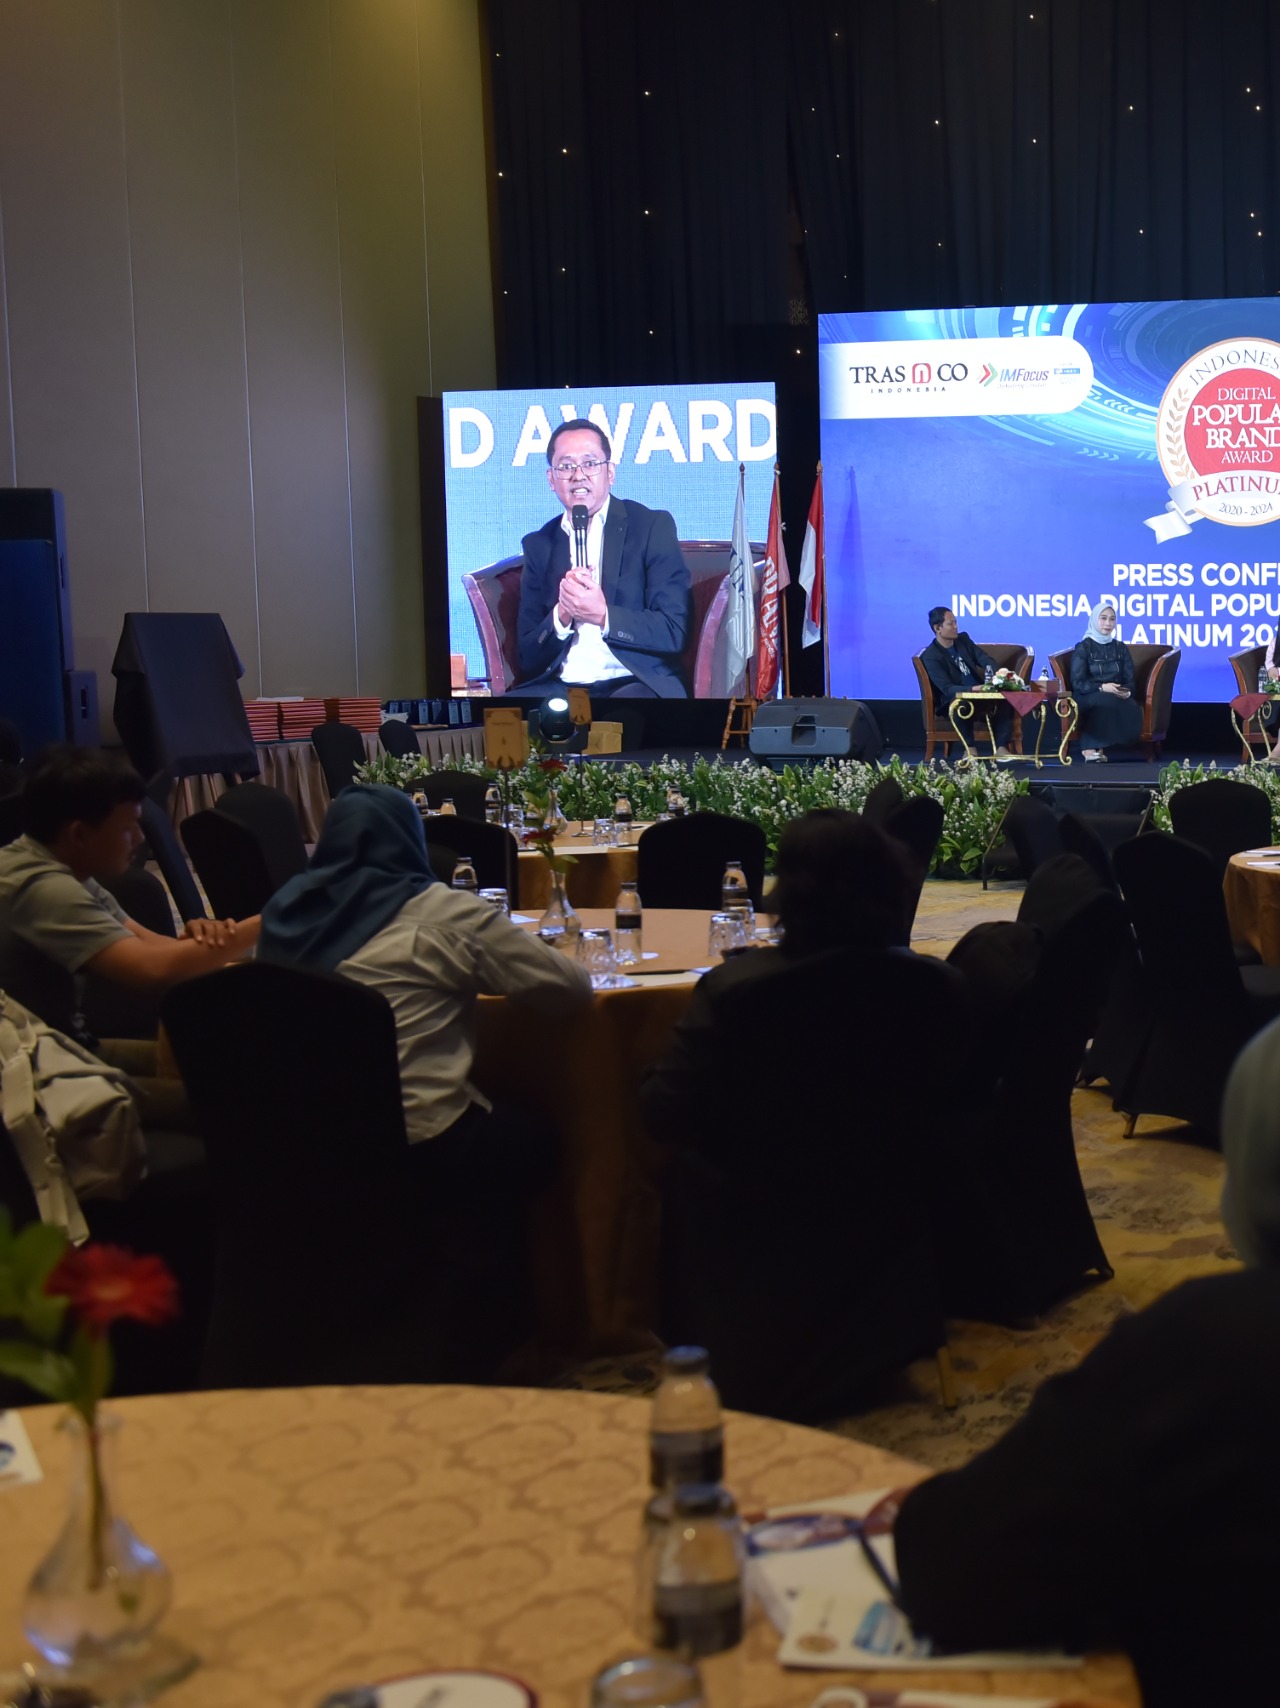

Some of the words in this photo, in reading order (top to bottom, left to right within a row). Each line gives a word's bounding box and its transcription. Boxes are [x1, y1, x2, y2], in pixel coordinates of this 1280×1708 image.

[849, 365, 906, 384] TRAS
[1217, 386, 1277, 401] DIGITAL
[448, 407, 494, 468] D
[511, 398, 777, 466] AWARD
[1221, 450, 1274, 464] AWARD
[1218, 502, 1243, 515] 2020
[1250, 502, 1274, 516] 2024
[1113, 563, 1195, 587] PRESS
[951, 594, 1092, 617] INDONESIA
[1111, 623, 1233, 647] LATINUM
